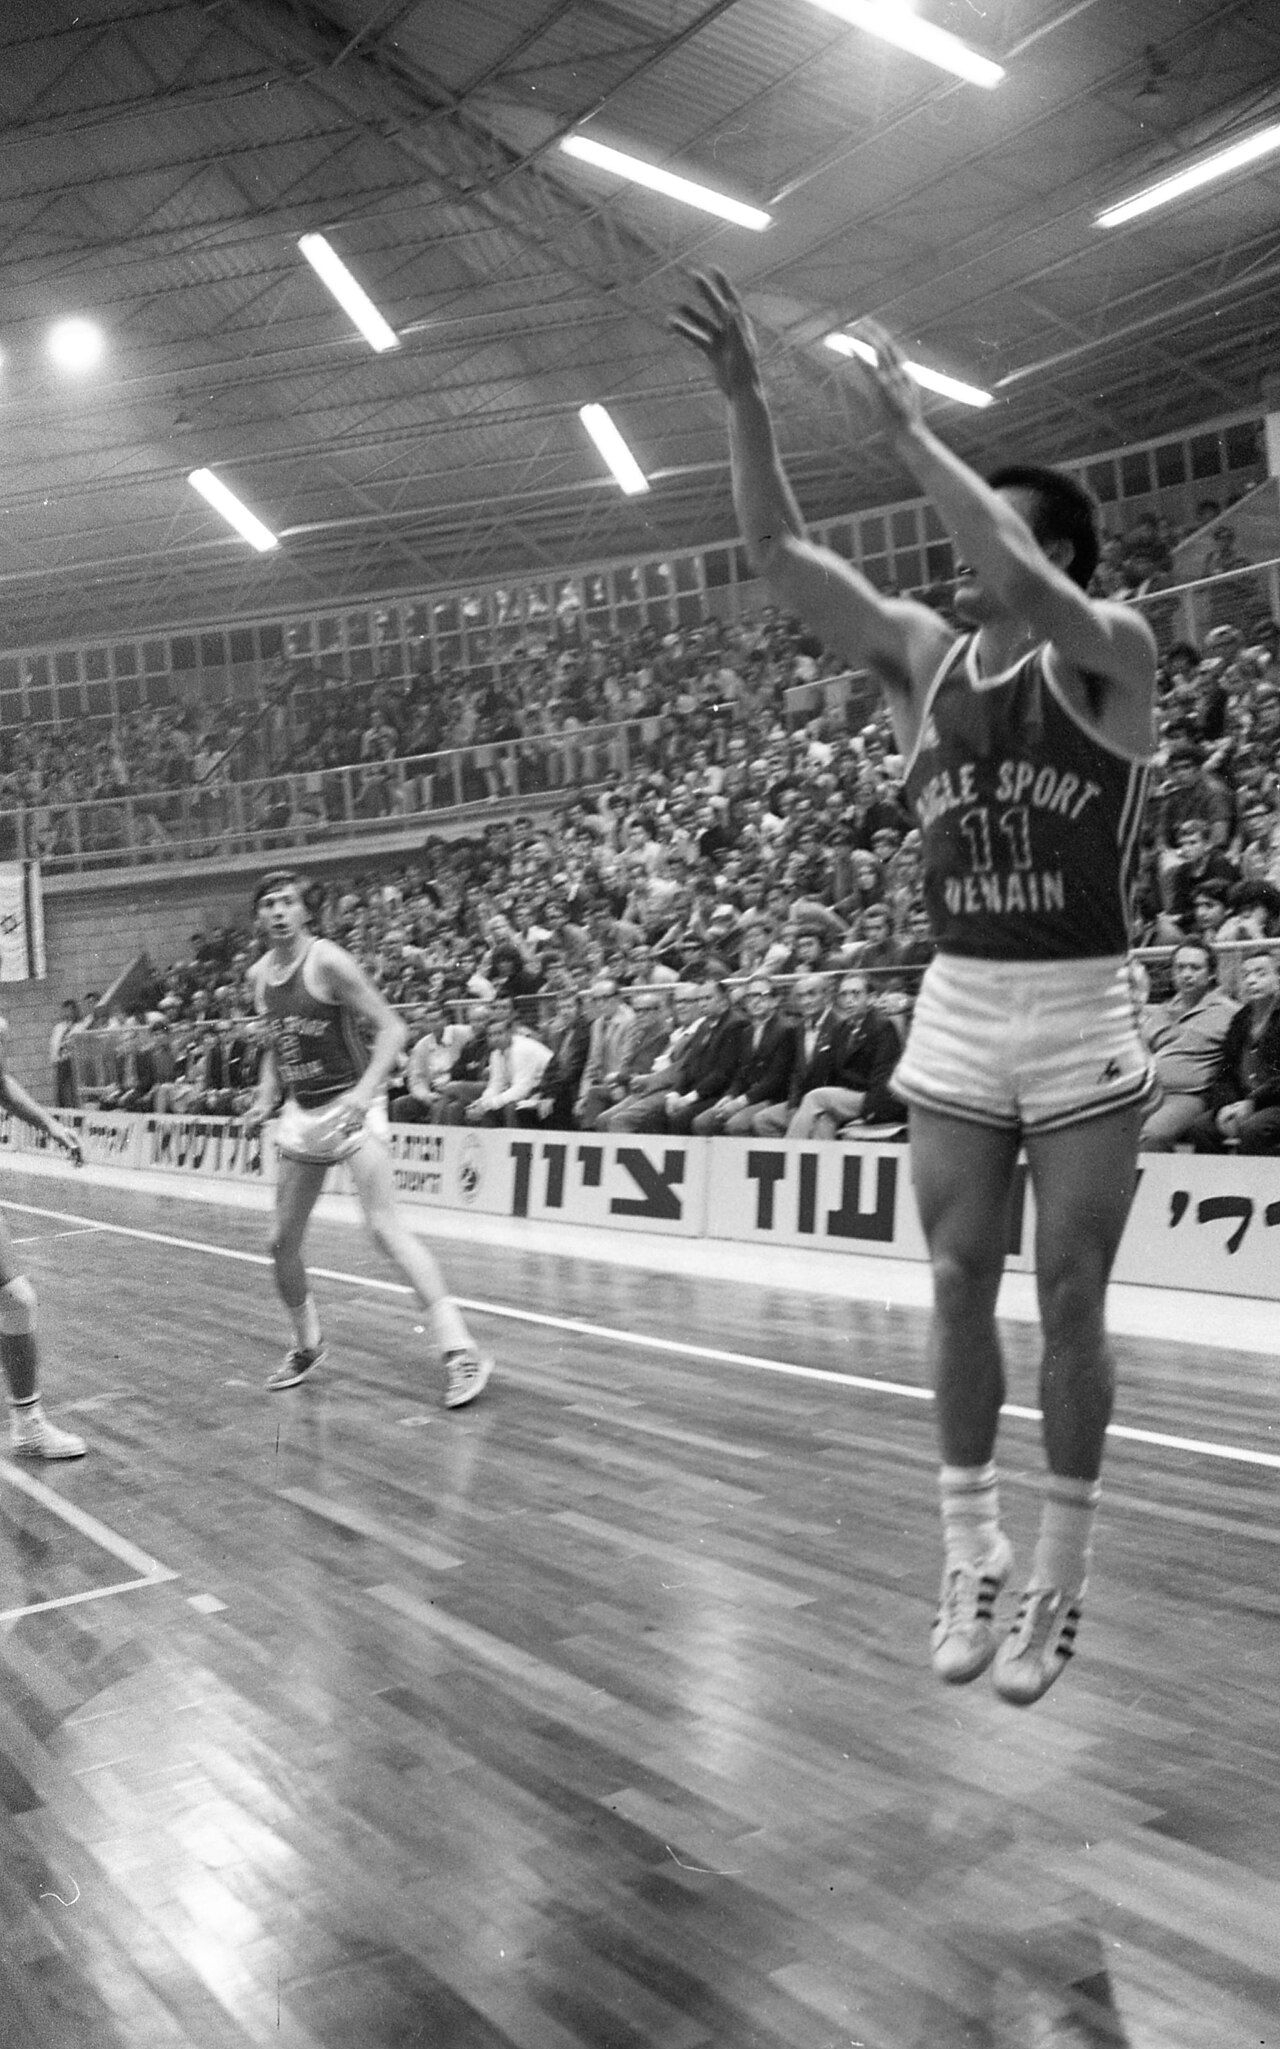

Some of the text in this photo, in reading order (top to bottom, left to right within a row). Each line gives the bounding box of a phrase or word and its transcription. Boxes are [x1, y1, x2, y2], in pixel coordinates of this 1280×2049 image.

[996, 760, 1101, 820] SPORT
[960, 806, 1033, 873] 11
[511, 1141, 687, 1220] ציון
